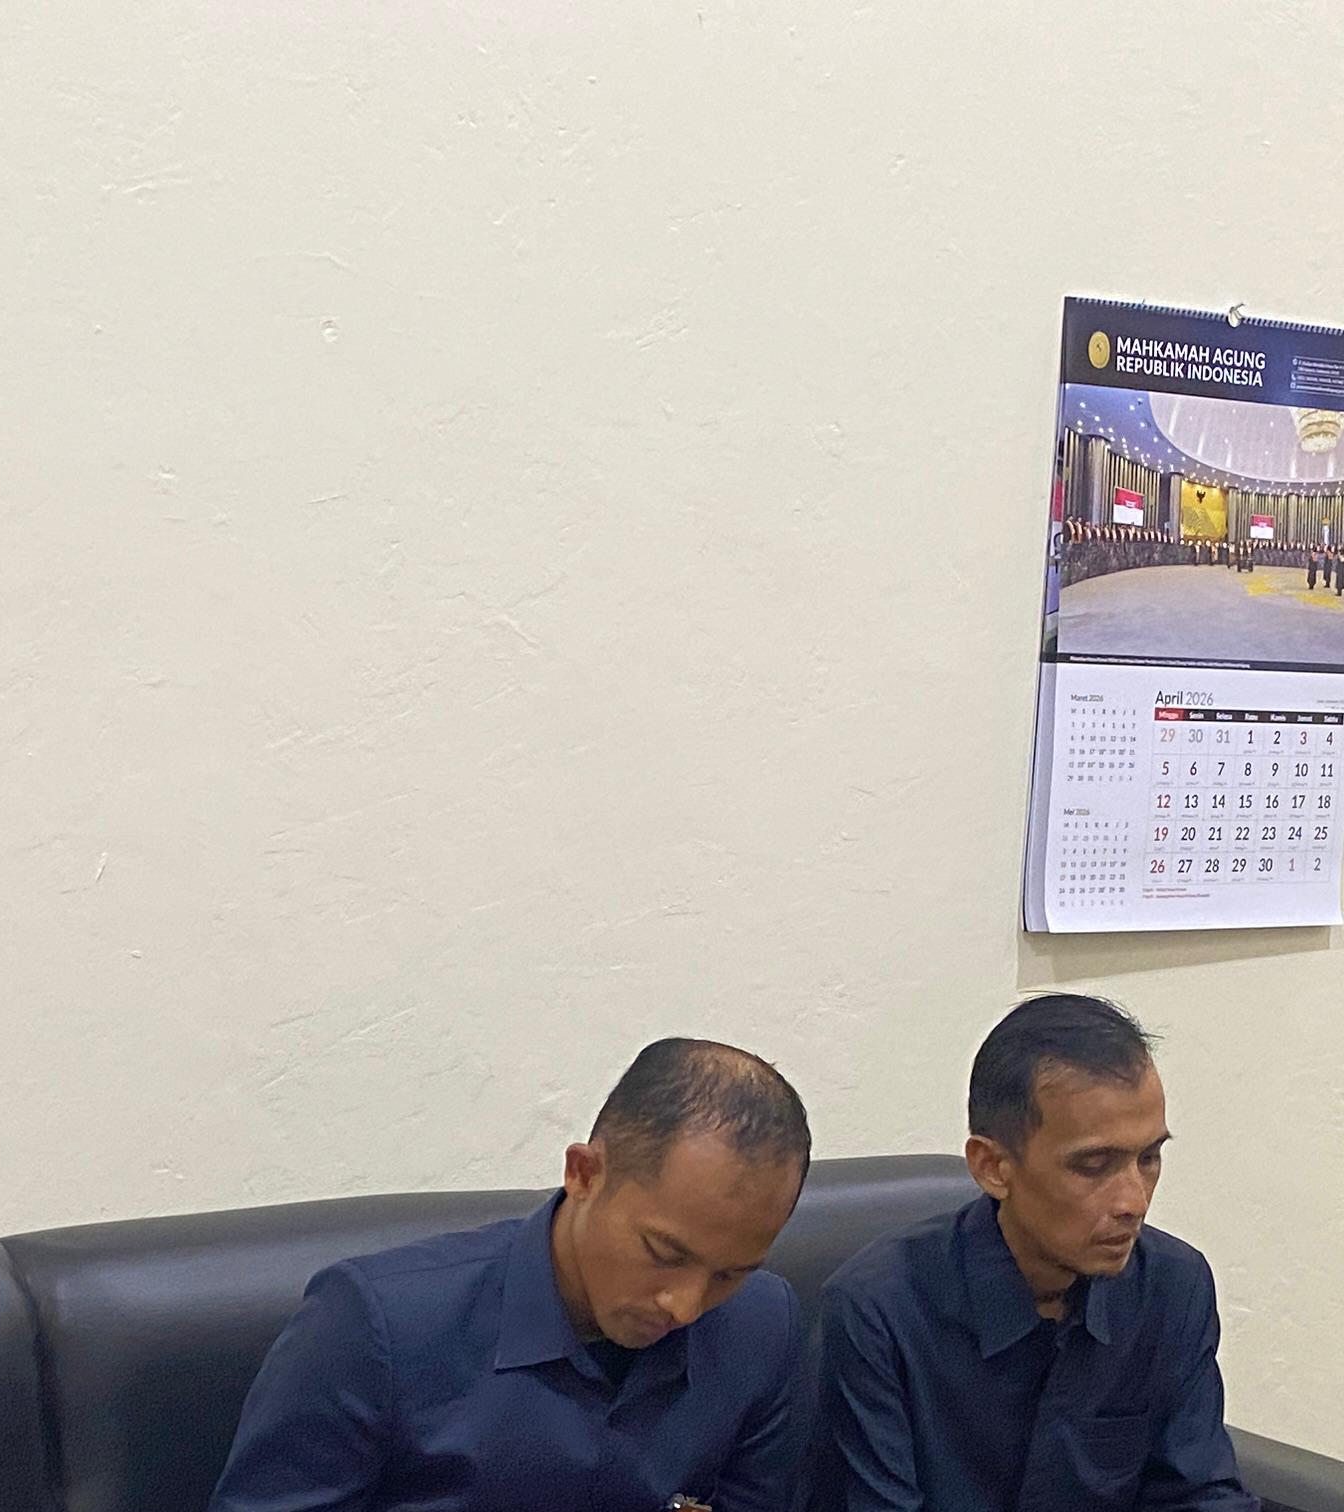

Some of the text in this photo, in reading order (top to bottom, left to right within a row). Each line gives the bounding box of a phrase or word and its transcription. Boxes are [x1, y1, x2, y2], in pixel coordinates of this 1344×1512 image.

[1116, 336, 1266, 369] MAHKAMAH AGUNG
[1116, 356, 1263, 386] REPUBLIK INDONESIA
[1155, 691, 1214, 708] April 2026
[1160, 728, 1332, 745] 29 30 31 1 2 3 4
[1162, 761, 1333, 777] 5 6 7 8 9 10 11
[1157, 794, 1331, 809] 12 13 14 15 16 17 18
[1154, 826, 1328, 841] 19 20 21 22 23 24 25
[1150, 858, 1321, 873] 26 27 28 29 30 1 2
